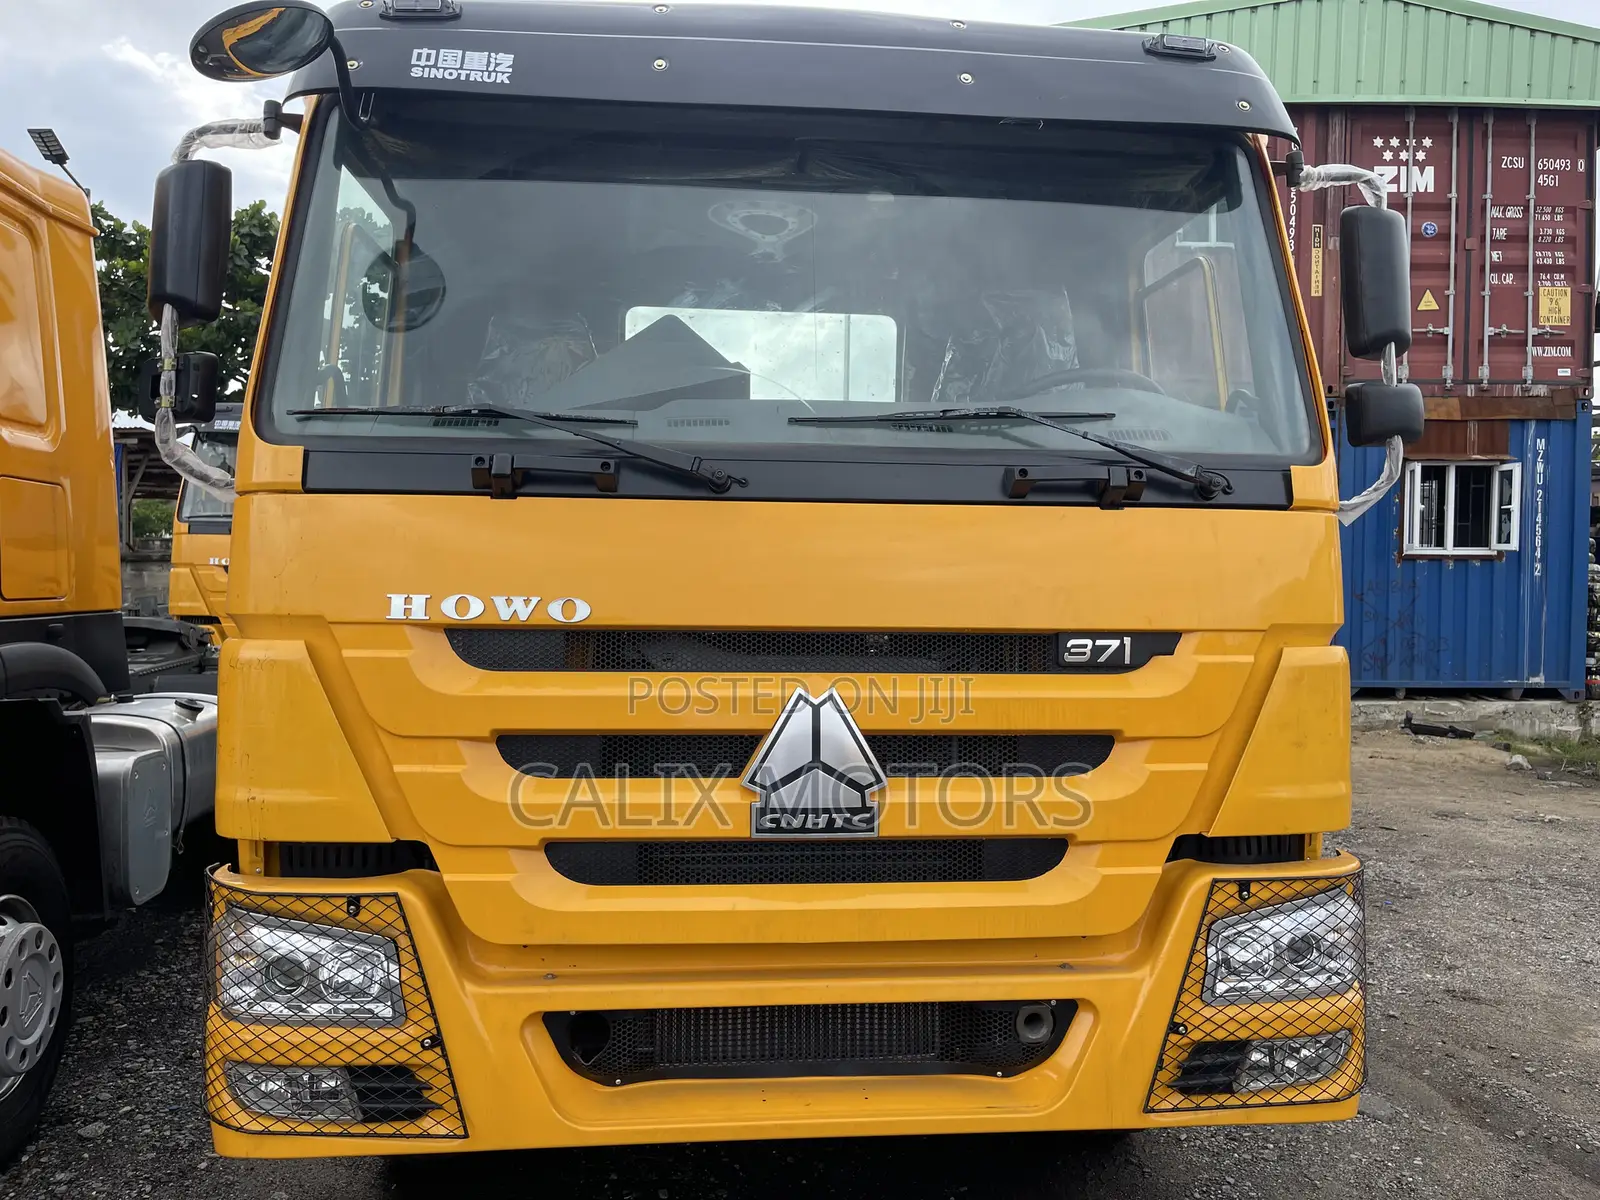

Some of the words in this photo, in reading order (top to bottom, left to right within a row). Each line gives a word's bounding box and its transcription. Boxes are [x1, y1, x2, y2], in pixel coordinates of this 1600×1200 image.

[410, 48, 515, 72] 中国重汽
[410, 66, 512, 84] SINOTRUK
[1501, 156, 1525, 169] ZCSU
[1537, 158, 1571, 171] 650493
[1374, 166, 1435, 193] ZIM
[1537, 174, 1559, 187] 45G1
[1505, 206, 1524, 218] GROSS
[1492, 228, 1508, 240] TARE
[1490, 251, 1503, 262] NET
[1543, 289, 1568, 297] CAUTION
[1548, 307, 1562, 315] HIGH
[1540, 316, 1571, 324] CONTAINER
[1536, 438, 1545, 485] MZWU
[385, 593, 592, 623] HOWO
[1063, 636, 1132, 665] 371
[759, 813, 872, 829] CNHTC
